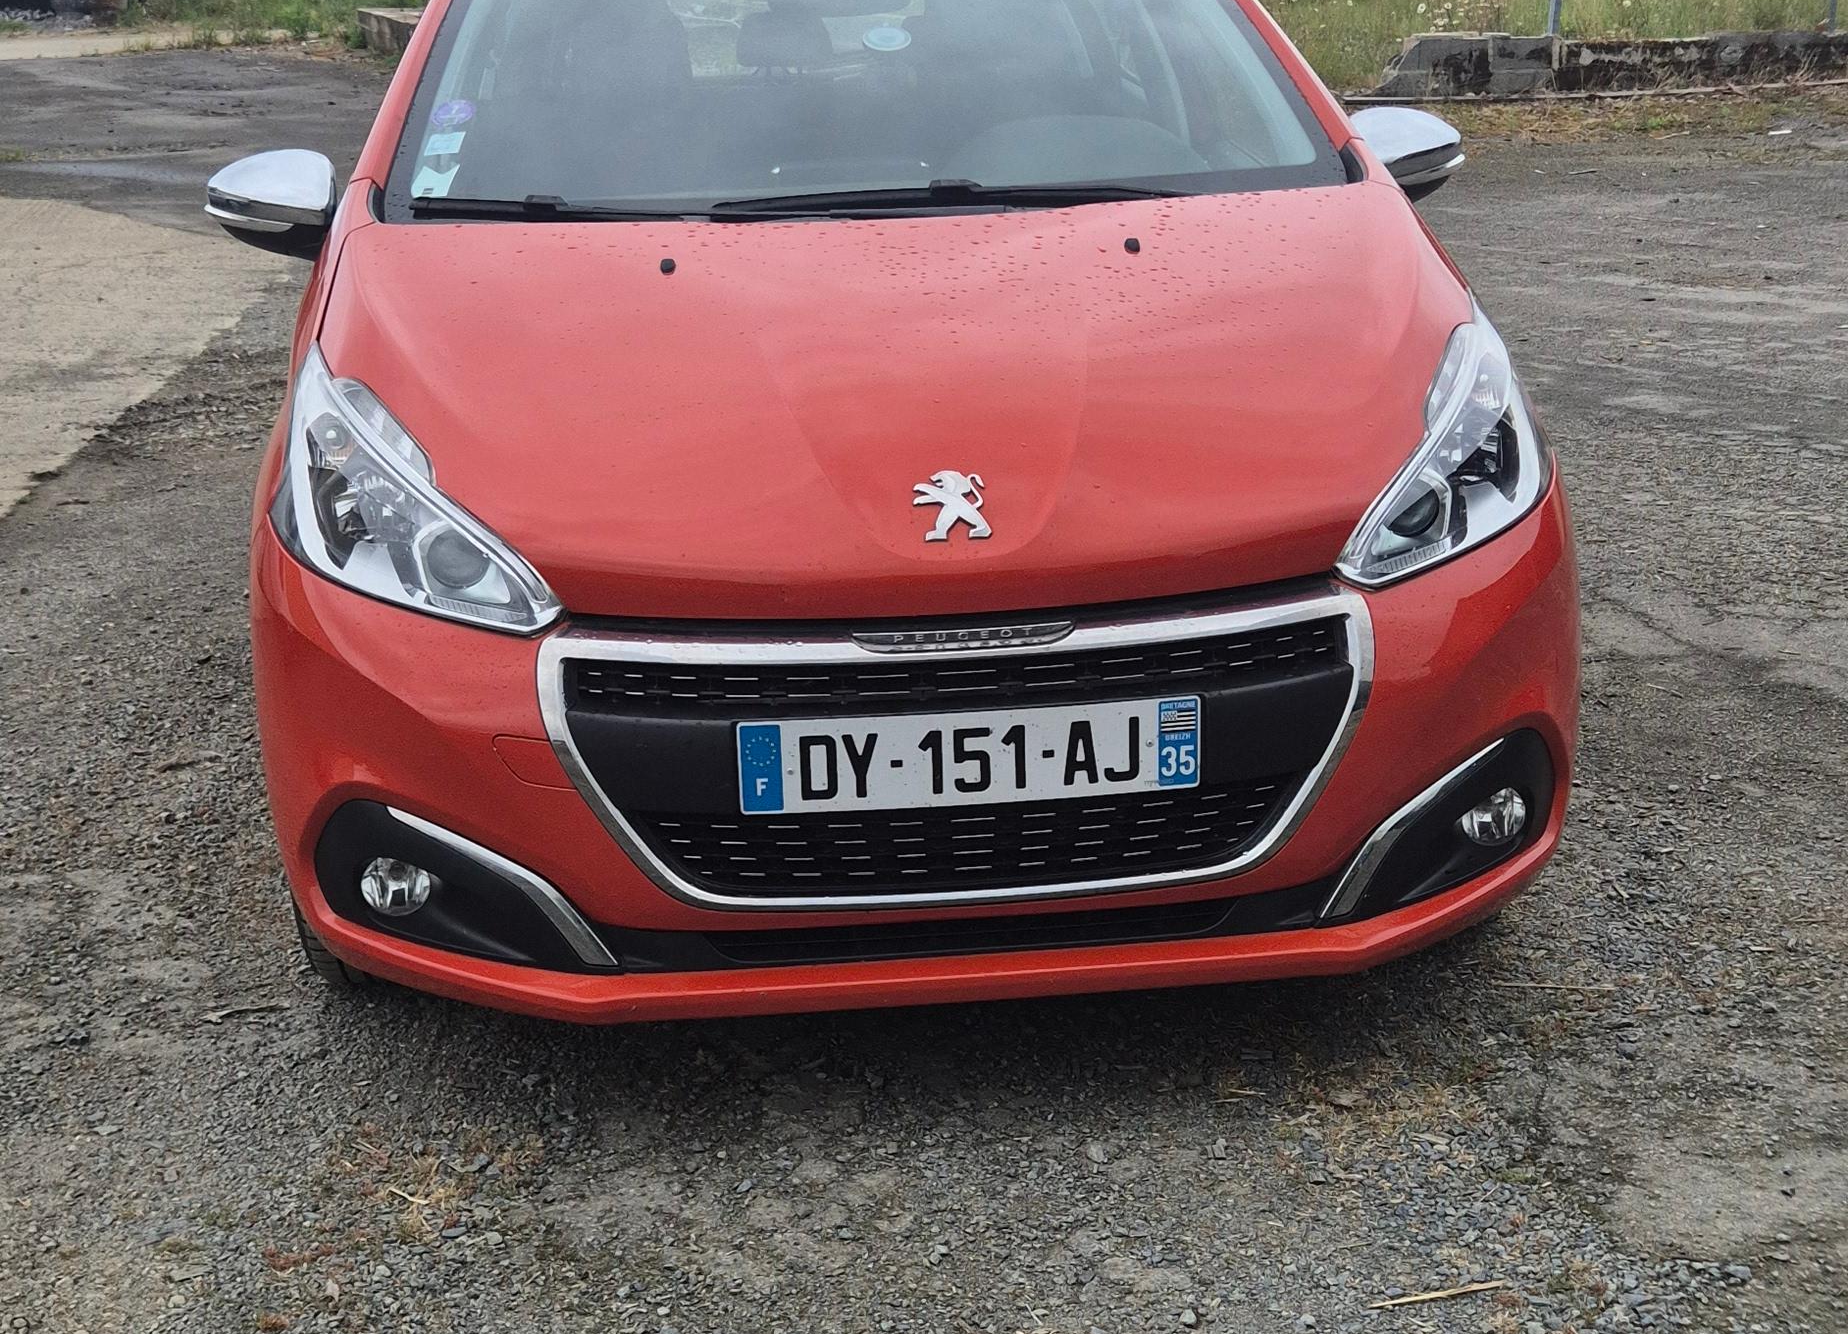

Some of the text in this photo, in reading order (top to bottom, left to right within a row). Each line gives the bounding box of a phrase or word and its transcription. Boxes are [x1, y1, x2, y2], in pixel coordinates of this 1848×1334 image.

[893, 627, 1033, 644] PEUGEOT
[799, 716, 1140, 801] DY-151-AJ
[1160, 744, 1196, 777] 35
[755, 777, 769, 797] F
